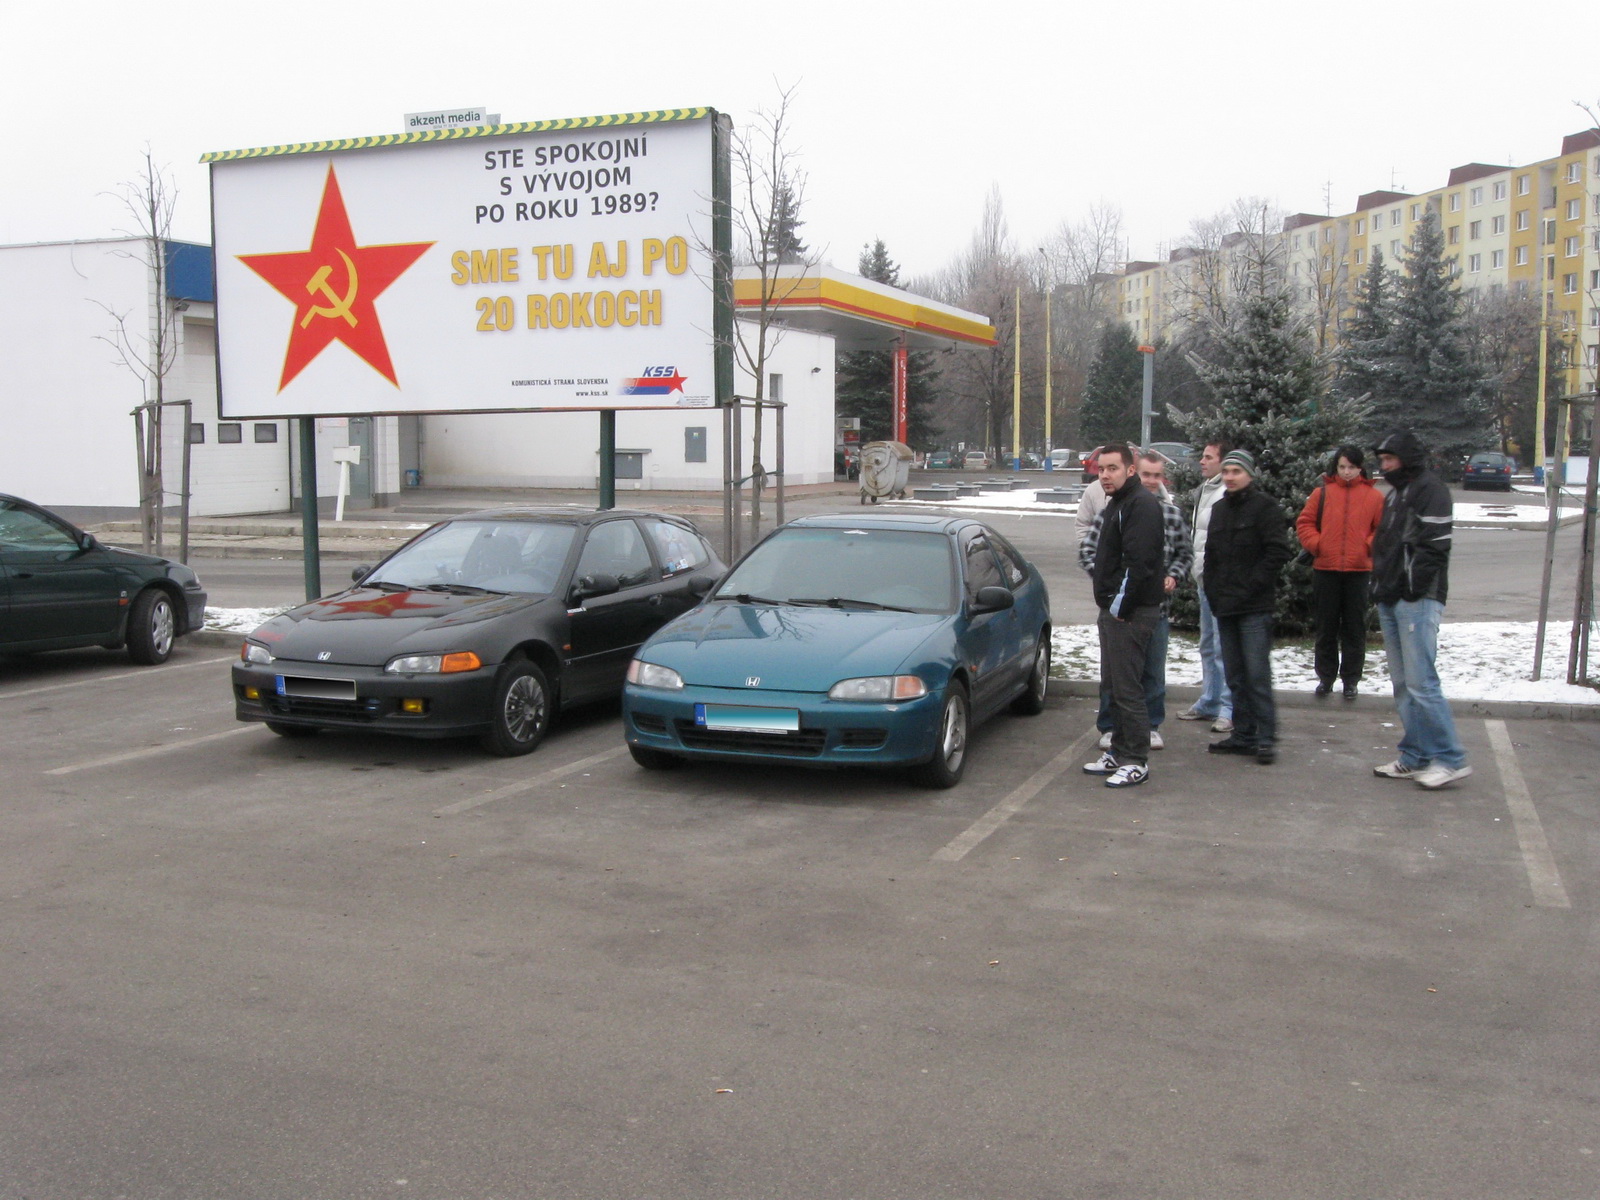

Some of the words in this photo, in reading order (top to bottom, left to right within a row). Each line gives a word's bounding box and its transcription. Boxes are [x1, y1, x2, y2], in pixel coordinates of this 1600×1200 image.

[410, 114, 445, 126] akzent
[448, 111, 481, 123] media
[485, 149, 524, 170] STE
[534, 133, 647, 165] SPOKOJNÍ
[500, 177, 512, 195] S
[523, 167, 632, 194] VÝVOJOM
[475, 204, 504, 224] PO
[516, 198, 578, 221] ROKU
[590, 191, 659, 216] 1989?
[451, 248, 519, 285] SME
[532, 244, 573, 280] TU
[587, 240, 627, 278] AJ
[642, 236, 688, 275] PO
[476, 296, 514, 331] 20
[527, 289, 662, 329] ROKOCH
[554, 378, 575, 386] STRANA
[577, 378, 609, 386] SLOVENSKA
[643, 365, 675, 377] KSS
